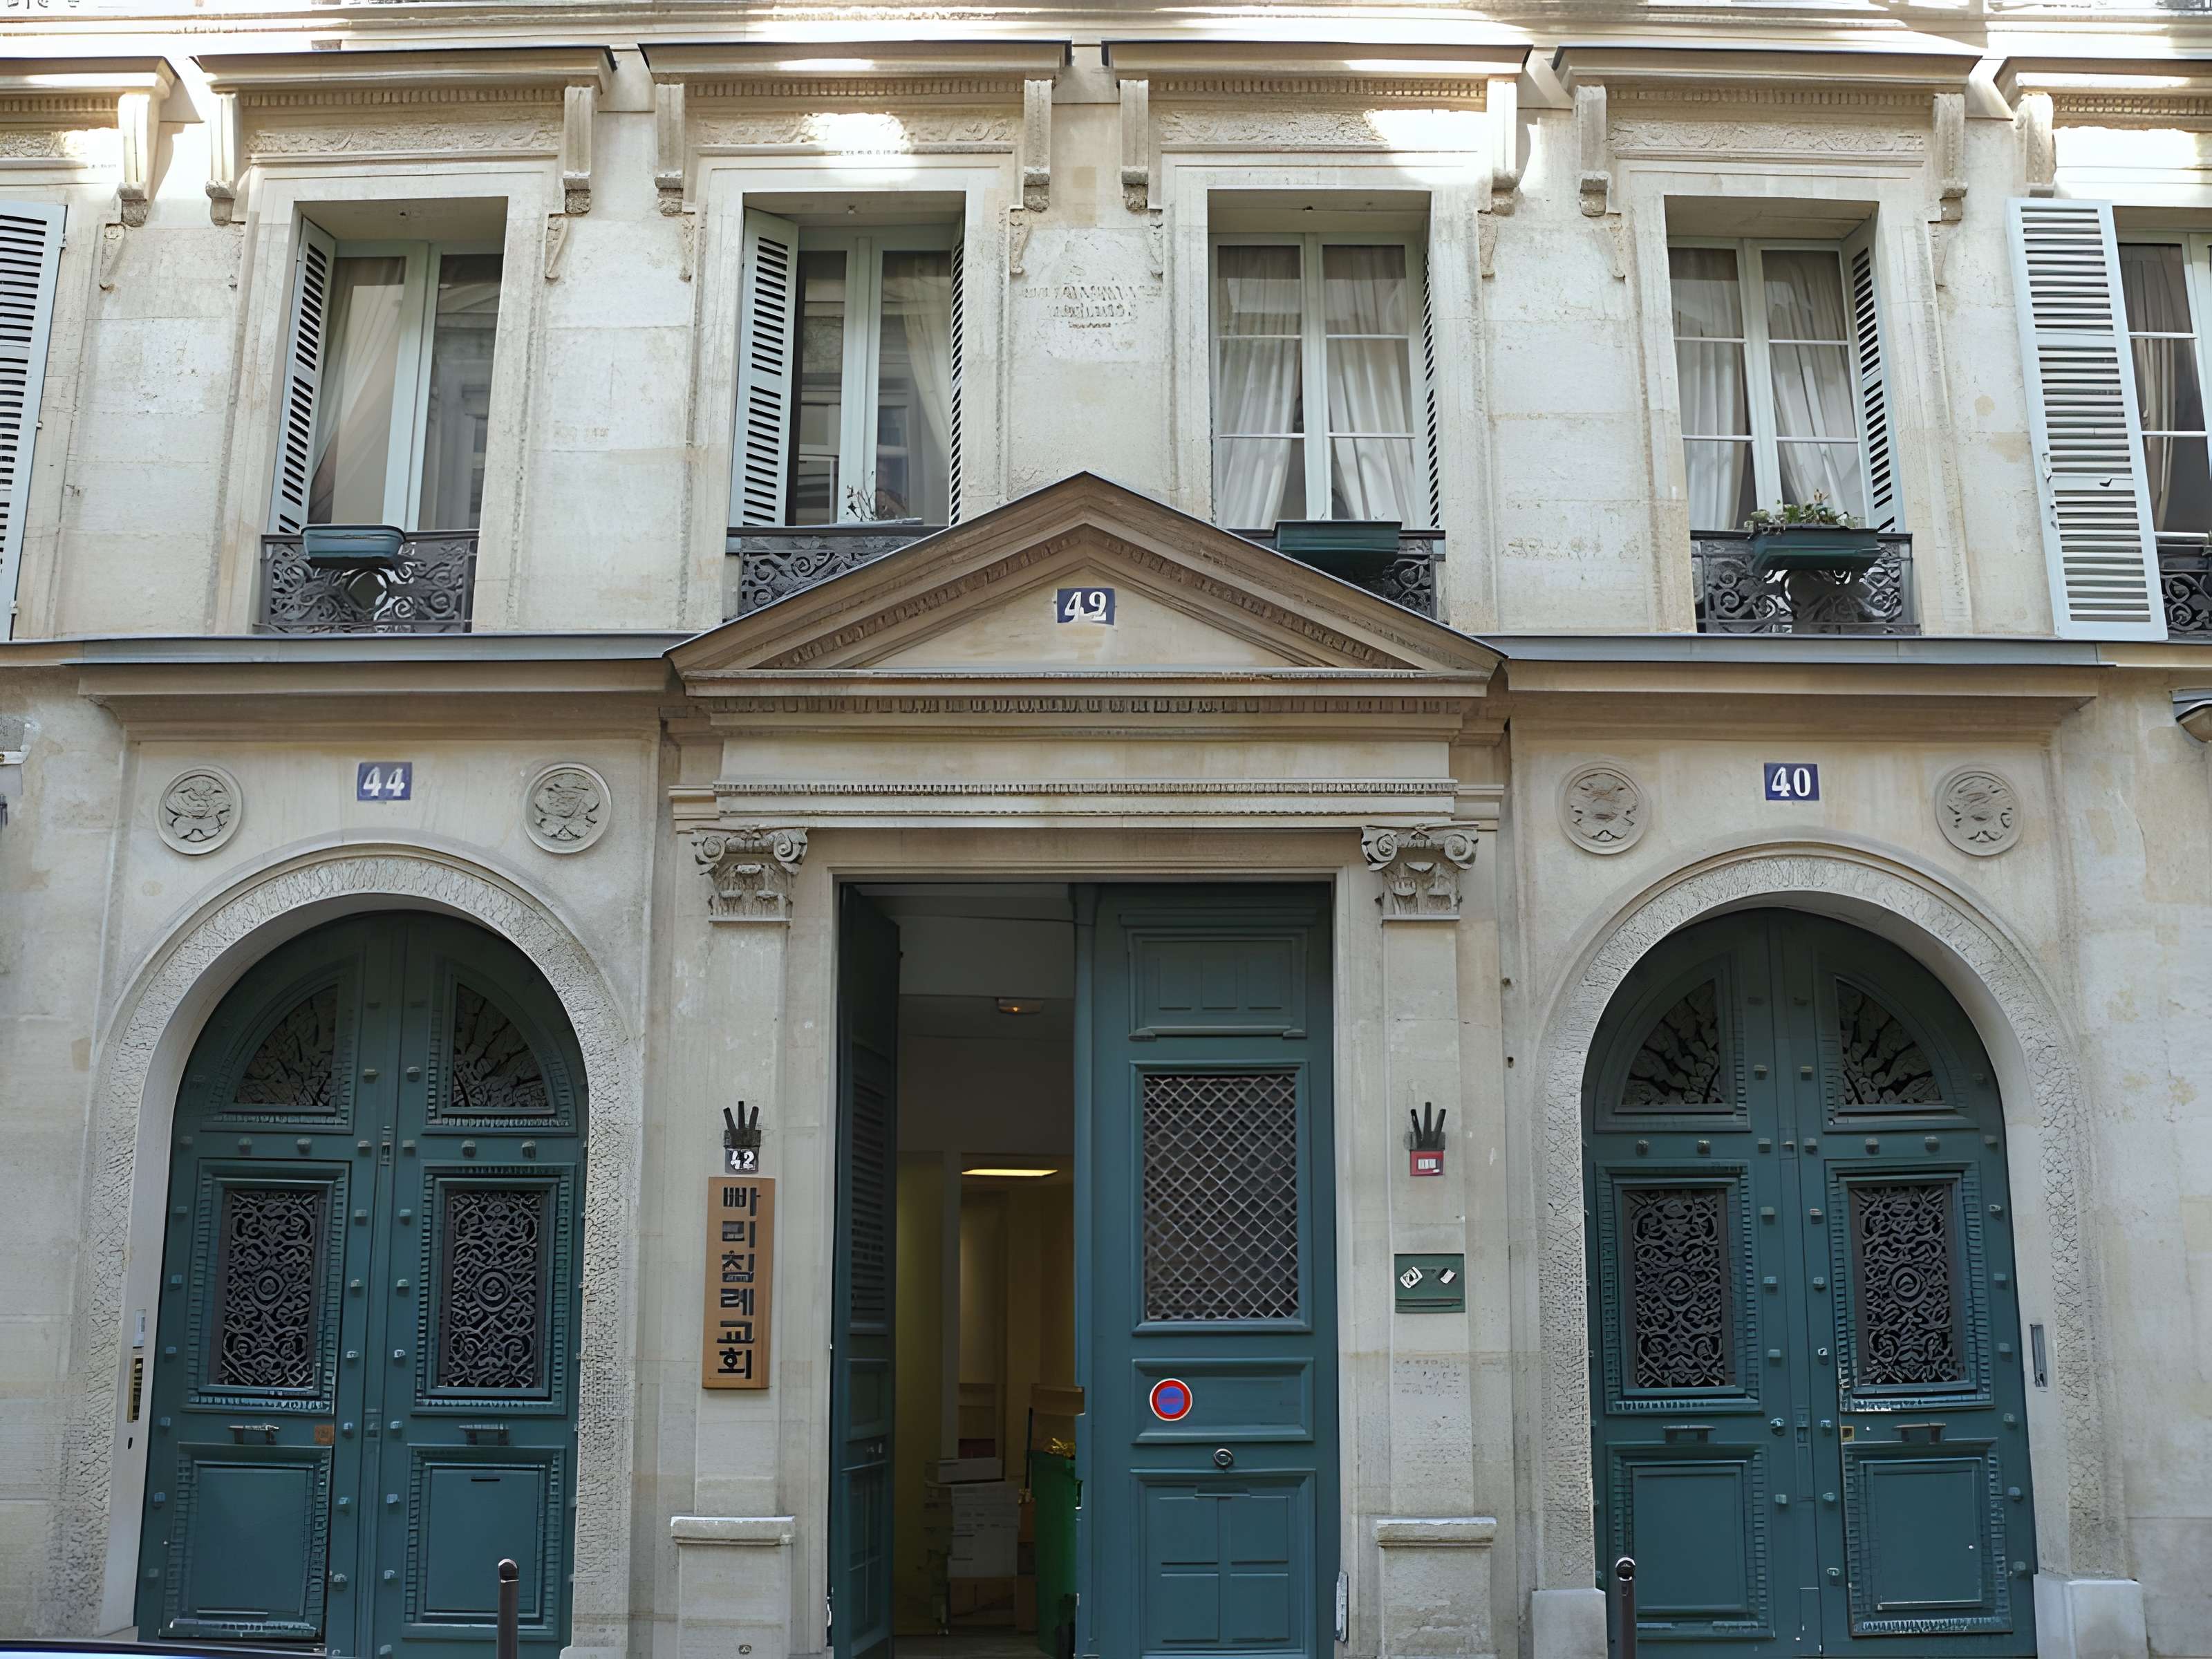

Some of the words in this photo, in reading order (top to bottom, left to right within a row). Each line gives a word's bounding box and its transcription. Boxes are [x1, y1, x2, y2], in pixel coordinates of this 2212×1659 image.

[363, 766, 405, 796] 44
[1772, 767, 1811, 796] 40
[730, 1150, 755, 1170] 42
